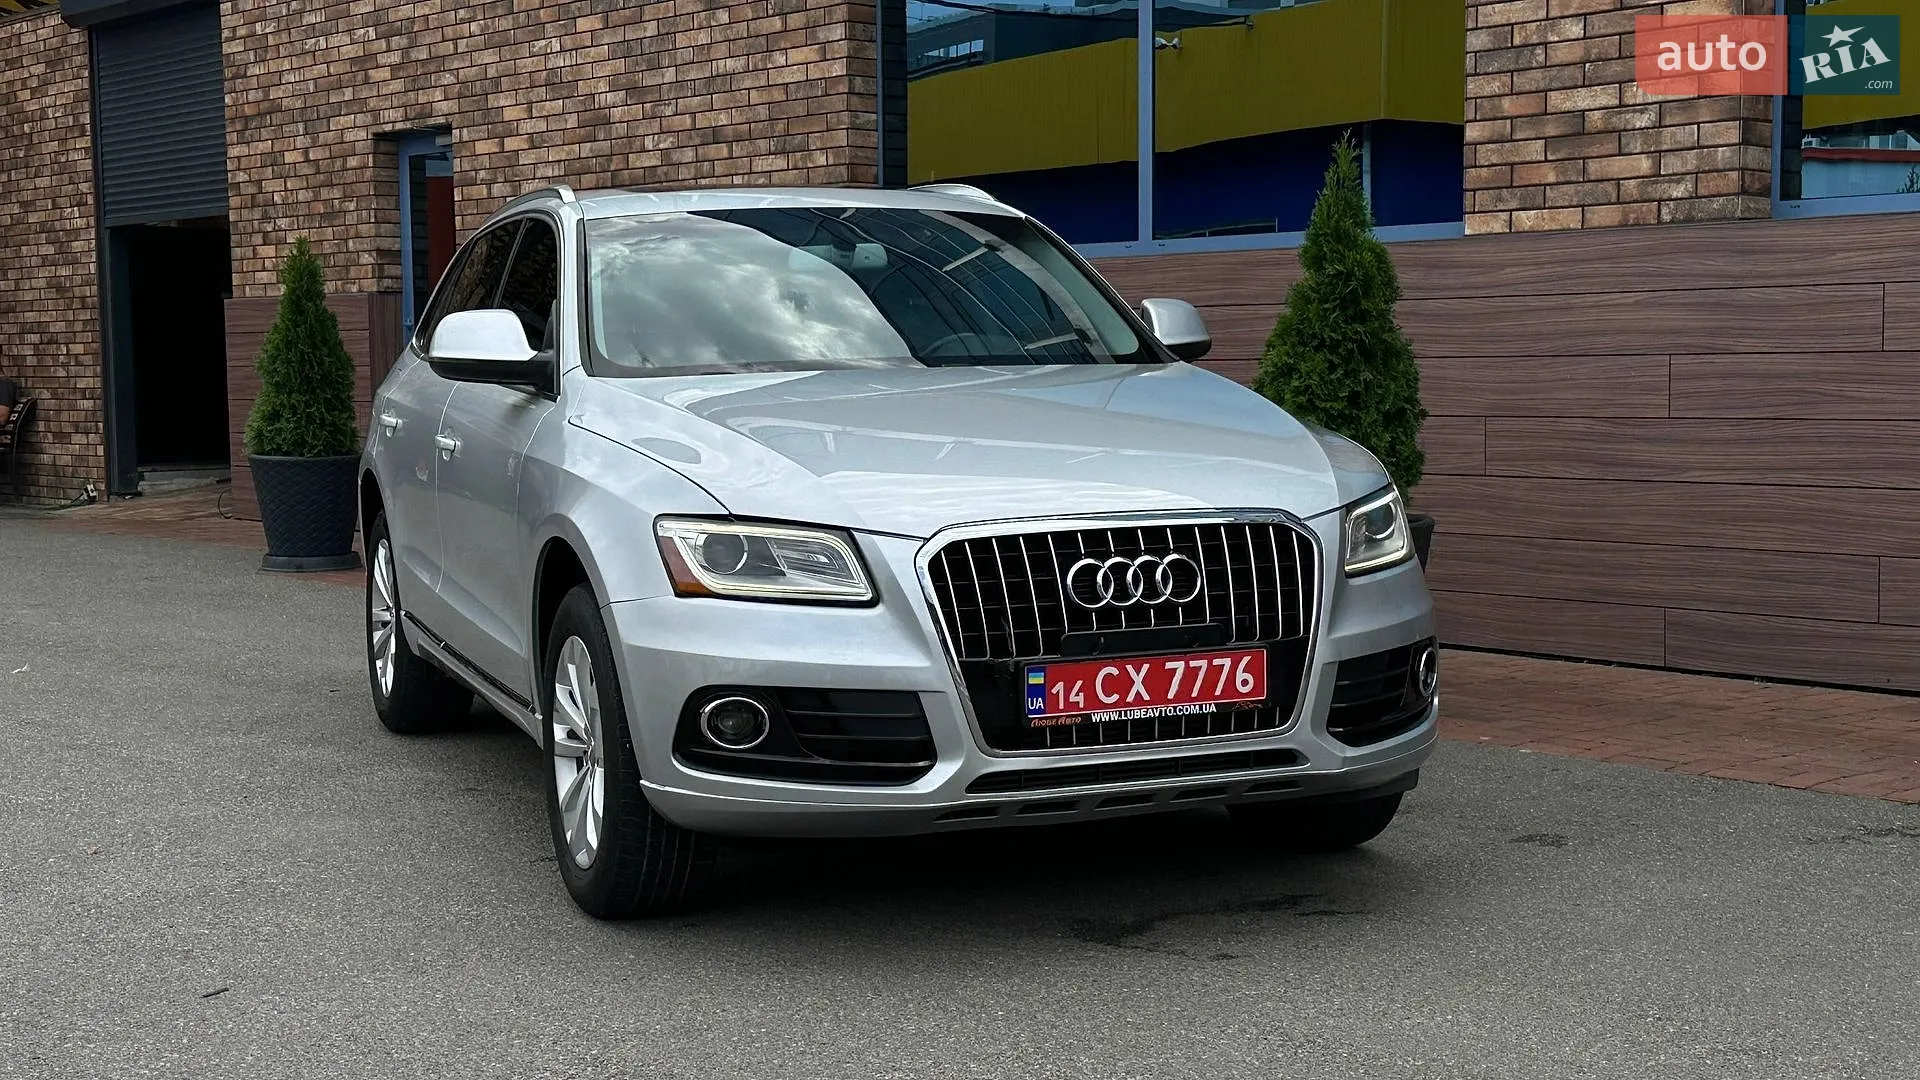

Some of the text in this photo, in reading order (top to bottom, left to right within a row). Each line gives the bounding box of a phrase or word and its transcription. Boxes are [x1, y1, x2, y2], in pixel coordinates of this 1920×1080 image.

[1051, 656, 1255, 710] 14 CX 7776
[1028, 697, 1044, 710] UA
[1091, 702, 1217, 723] WWW.LUBEAVTO.COM.UA
